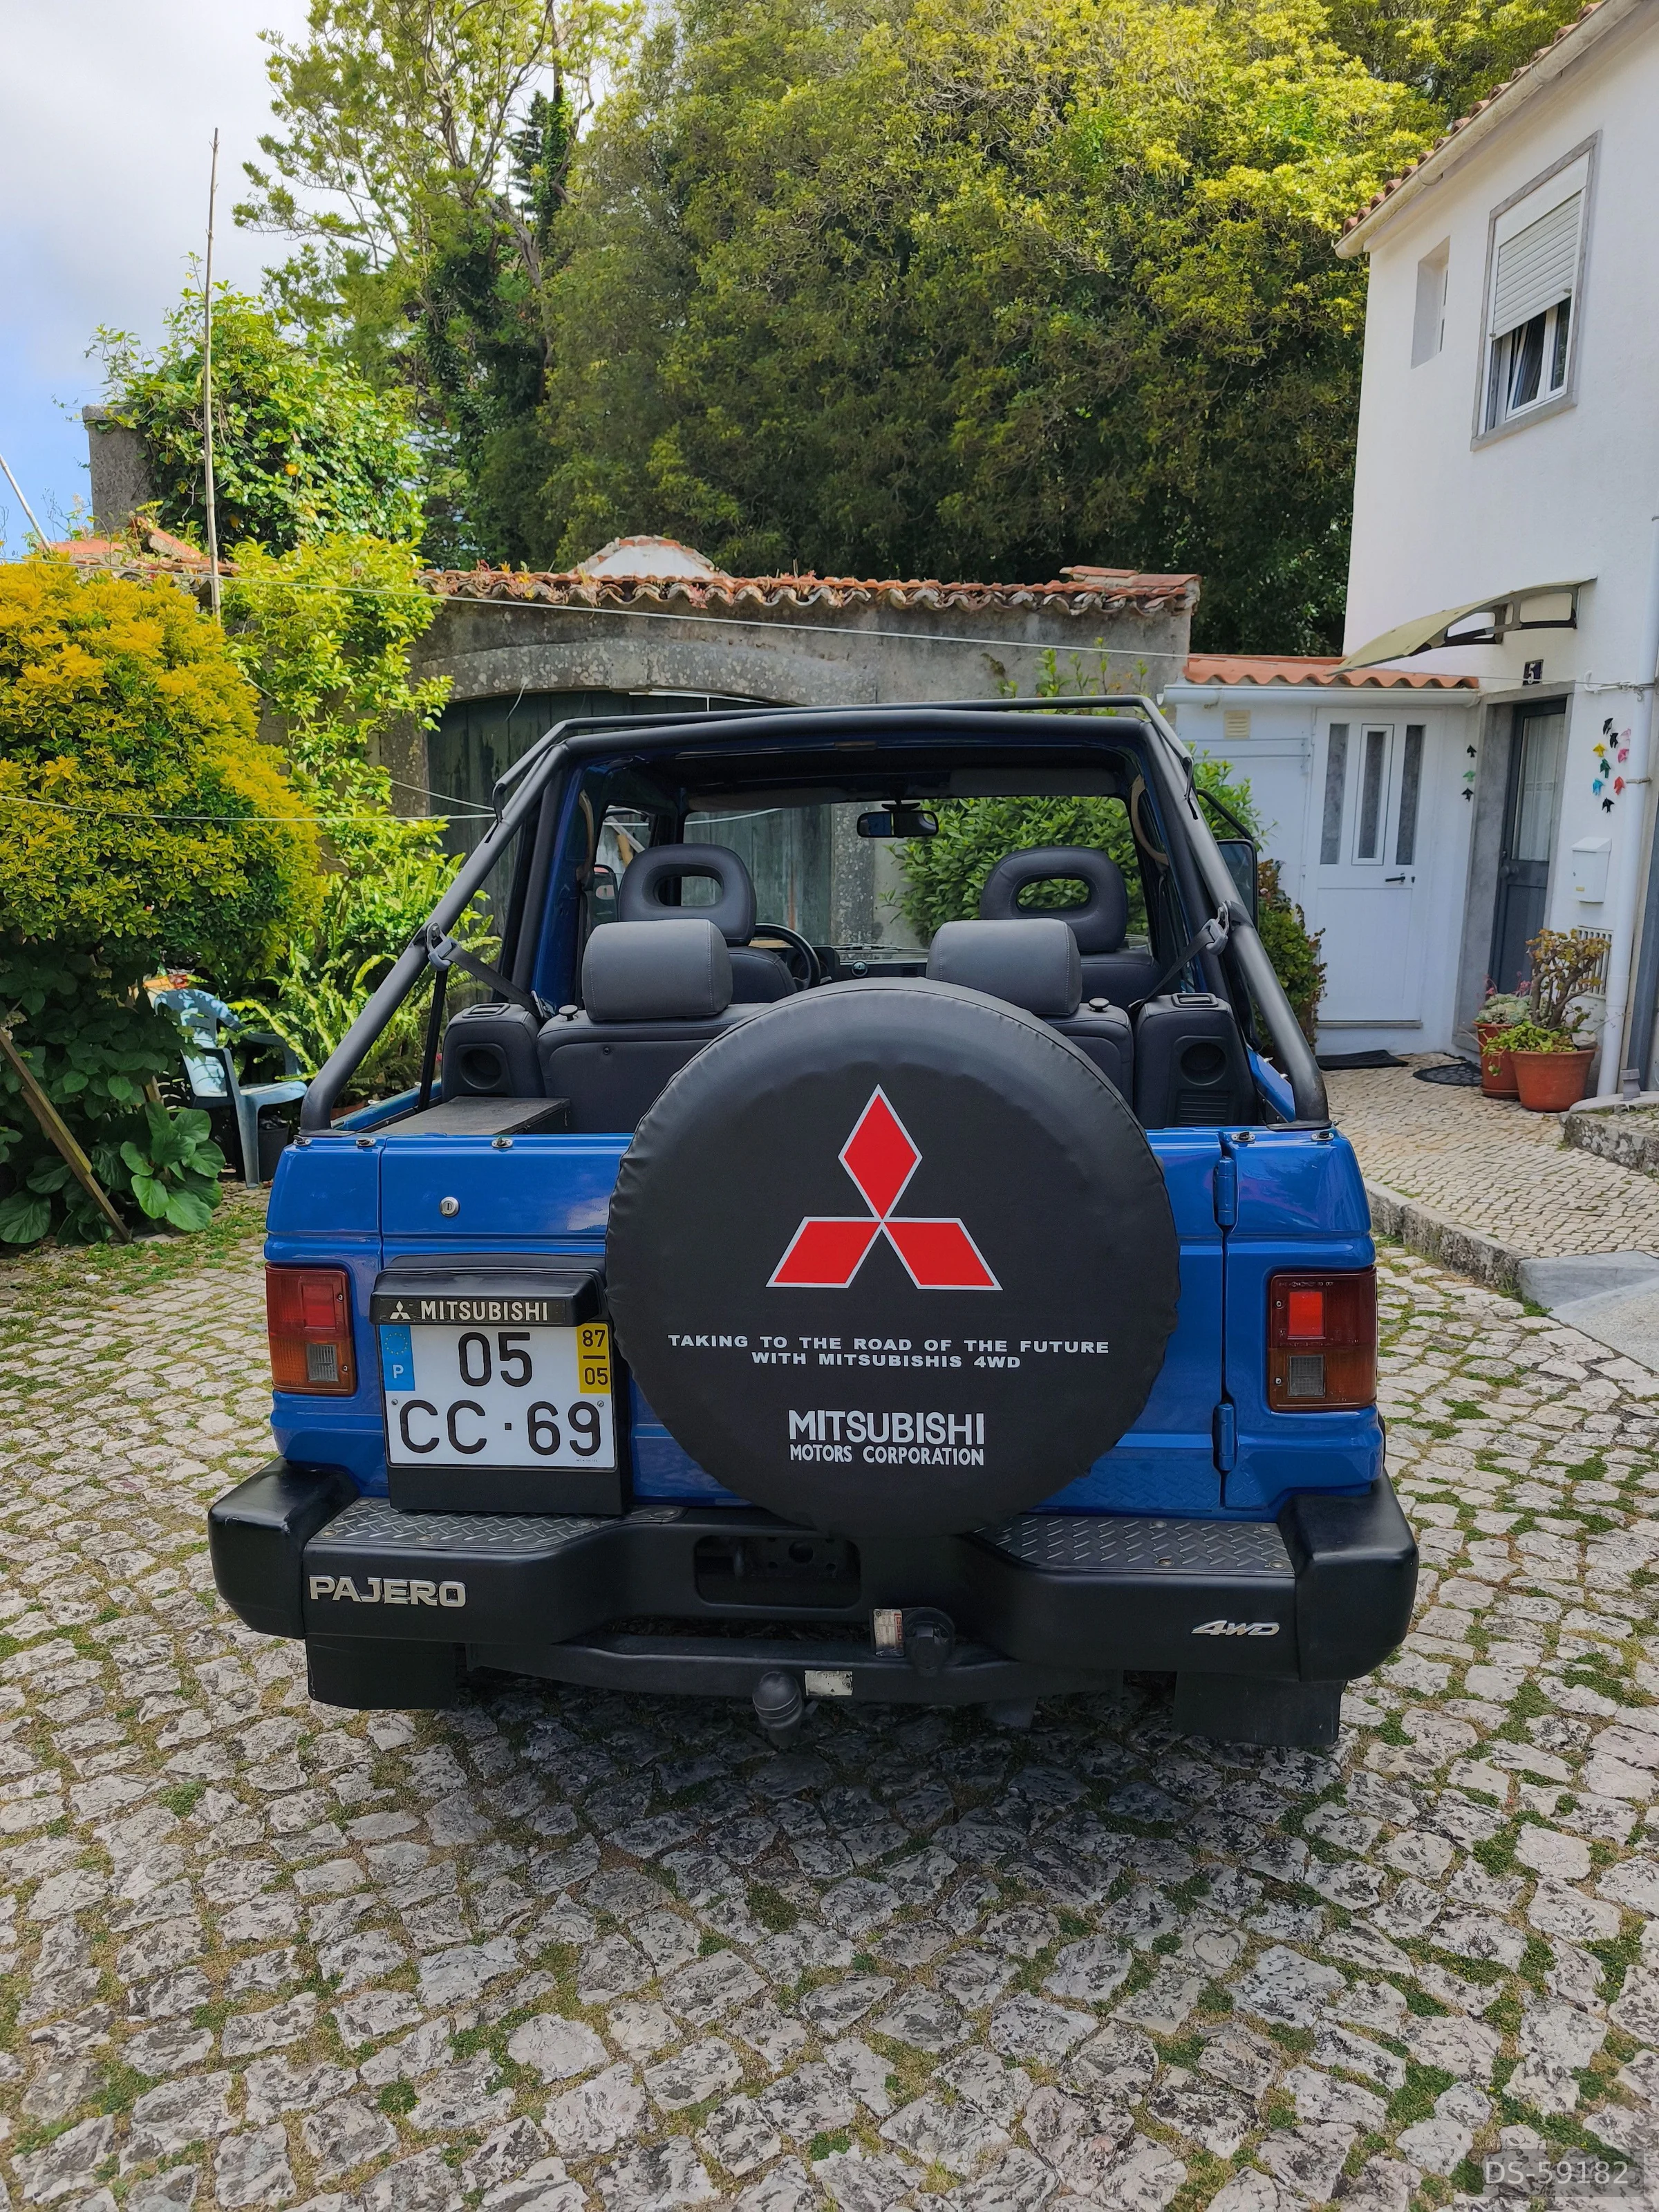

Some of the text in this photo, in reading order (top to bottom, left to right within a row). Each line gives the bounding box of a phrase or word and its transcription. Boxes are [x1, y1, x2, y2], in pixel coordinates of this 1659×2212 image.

[1528, 662, 1535, 684] 5
[420, 1300, 547, 1321] MITSUBISHI
[582, 1329, 606, 1347] 87
[668, 1334, 1109, 1353] TAKING TO THE ROAD OF THE FUTURE
[458, 1331, 533, 1387] 05
[751, 1351, 1020, 1369] WITH MITSUBISHIS 4WD
[393, 1364, 404, 1379] P
[584, 1367, 608, 1385] 05
[788, 1409, 984, 1445] MITSUBISHI
[789, 1443, 984, 1466] MOTORS CORPORATION
[309, 1575, 467, 1607] PAJERO
[1191, 1620, 1280, 1635] 4WD
